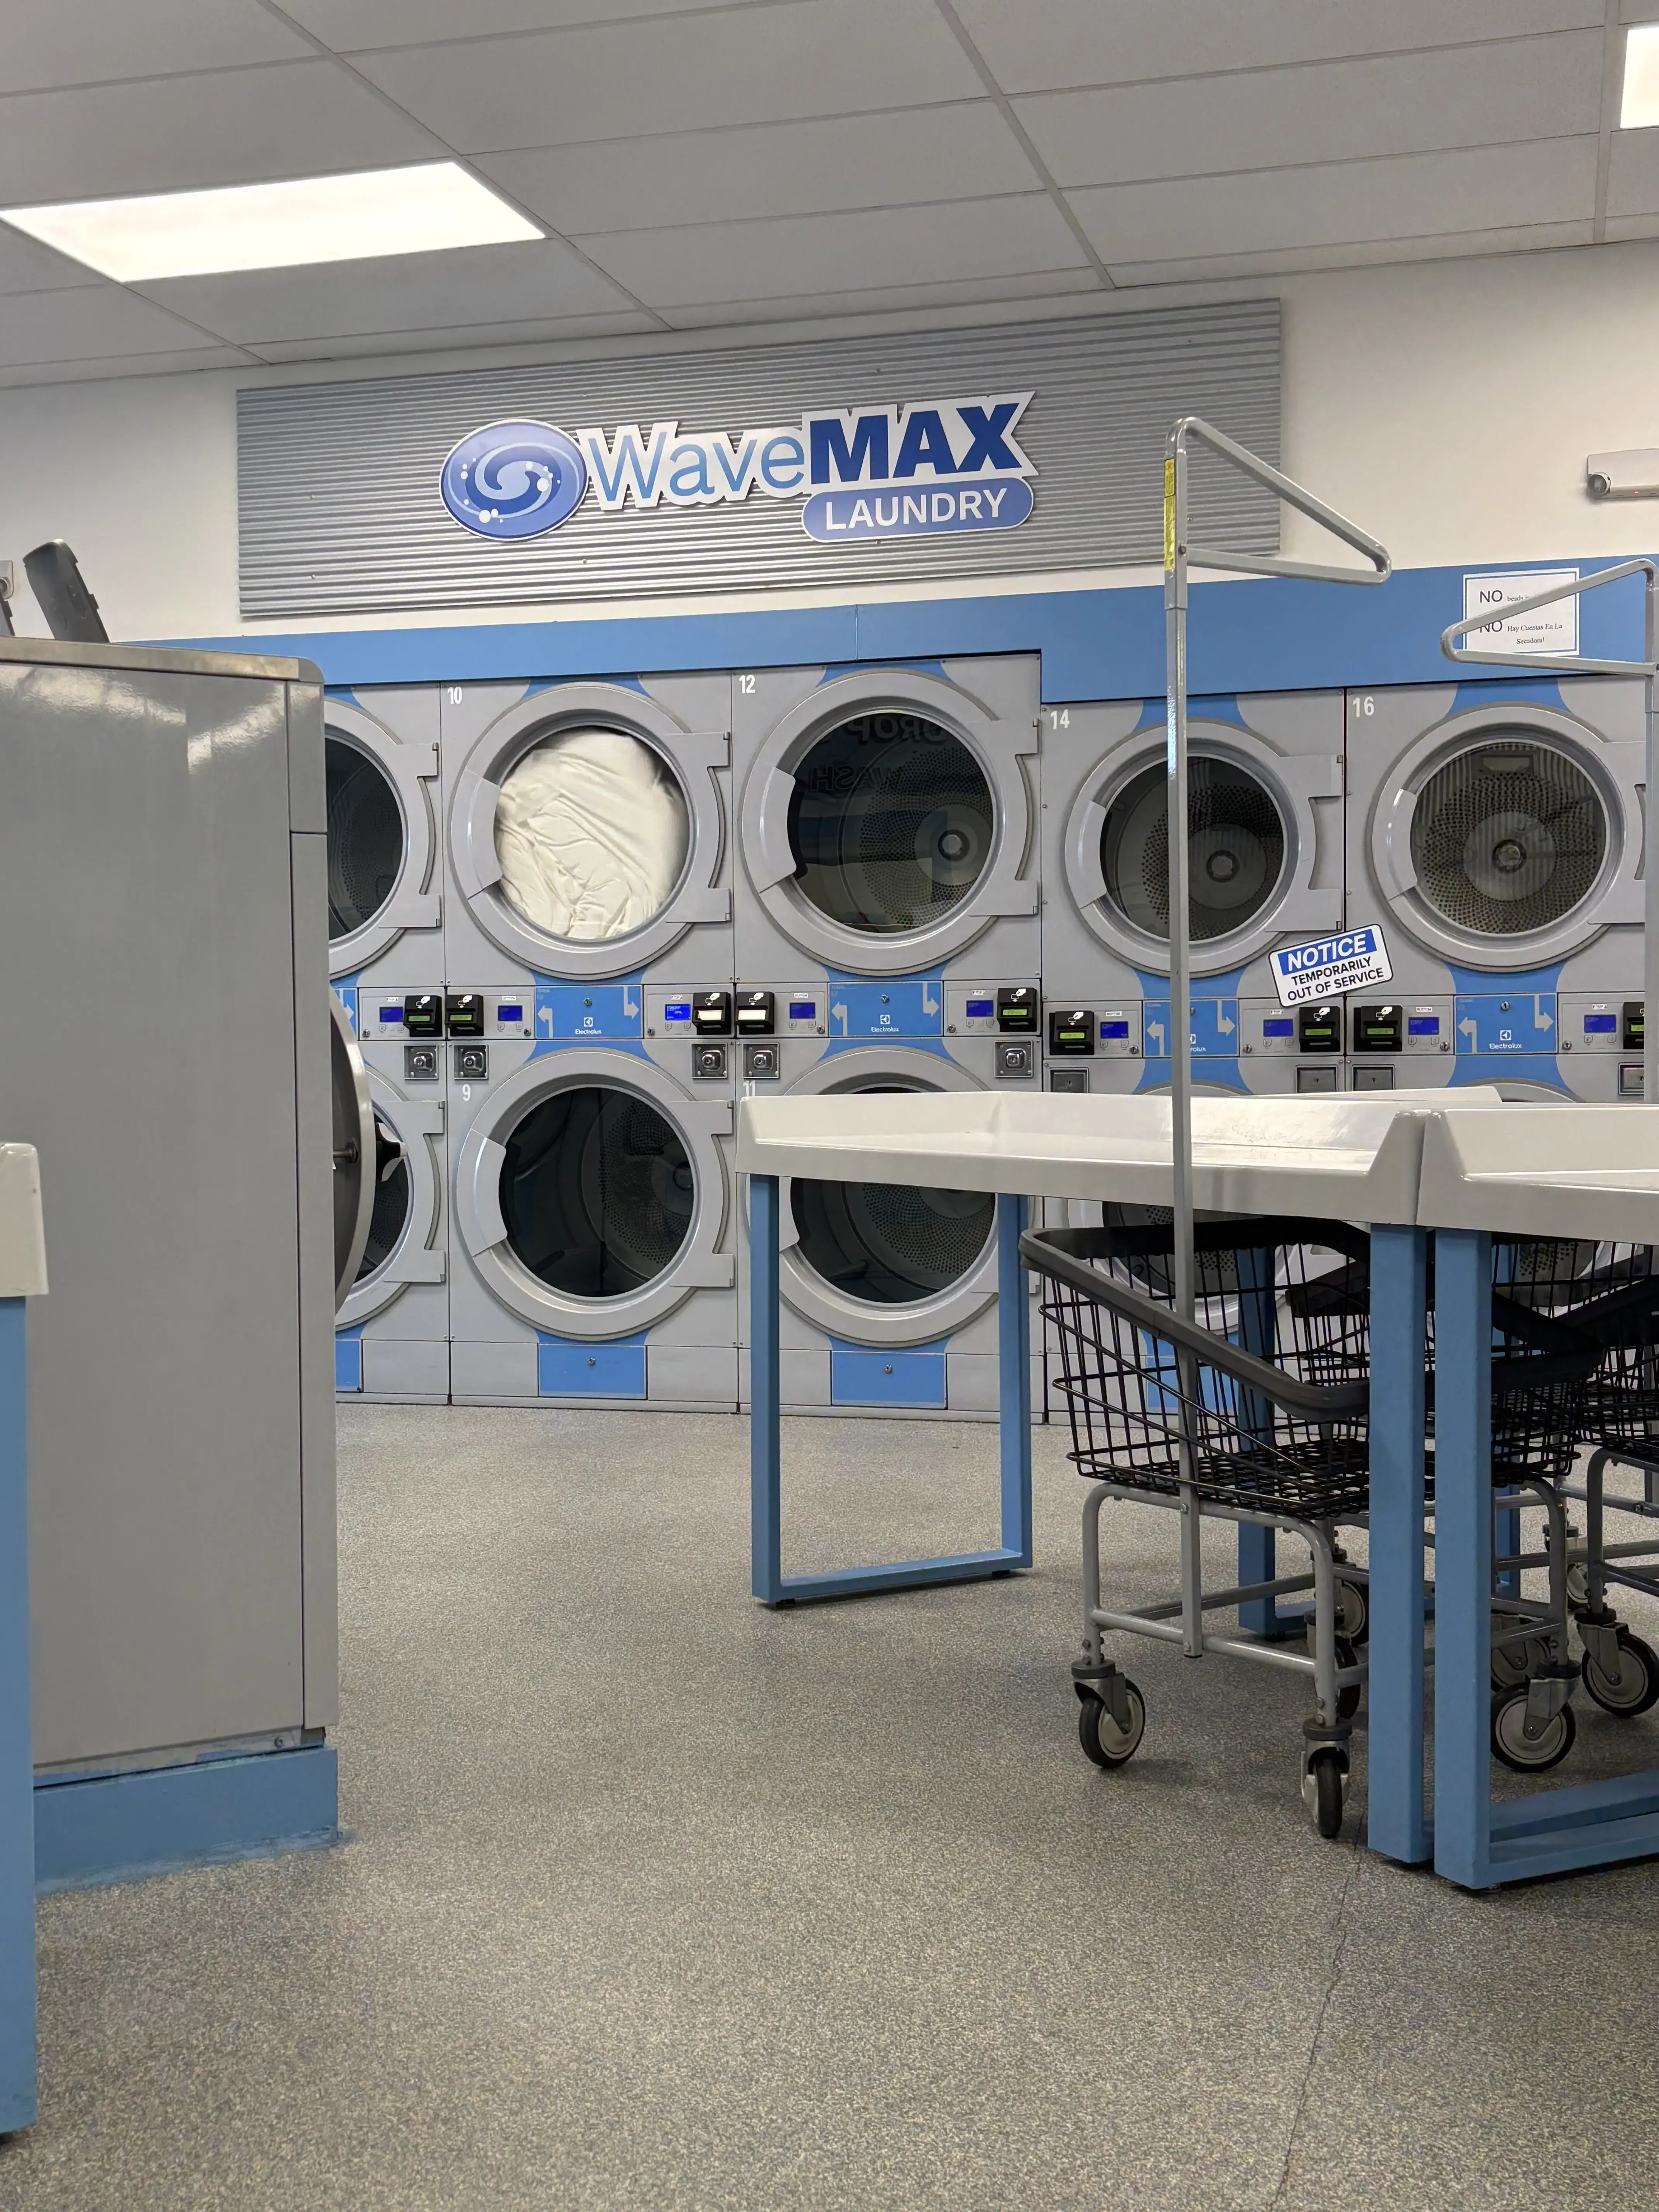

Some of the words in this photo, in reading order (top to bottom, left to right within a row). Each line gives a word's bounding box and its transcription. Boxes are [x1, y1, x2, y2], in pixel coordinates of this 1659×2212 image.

[589, 403, 1023, 499] WaveMAX
[826, 488, 1008, 530] LAUNDRY
[1480, 590, 1503, 603] NO
[1480, 620, 1503, 633] NO
[739, 675, 756, 694] 12
[447, 687, 462, 704] 10
[1352, 697, 1375, 717] 16
[1050, 709, 1070, 730] 14
[1287, 934, 1367, 971] NOTICE
[1291, 956, 1371, 986] TEMPORARILY
[1288, 986, 1312, 1001] OUT
[1315, 980, 1331, 994] OF
[1334, 968, 1384, 989] SERVICE
[462, 1084, 471, 1101] 9
[744, 1081, 756, 1096] 11
